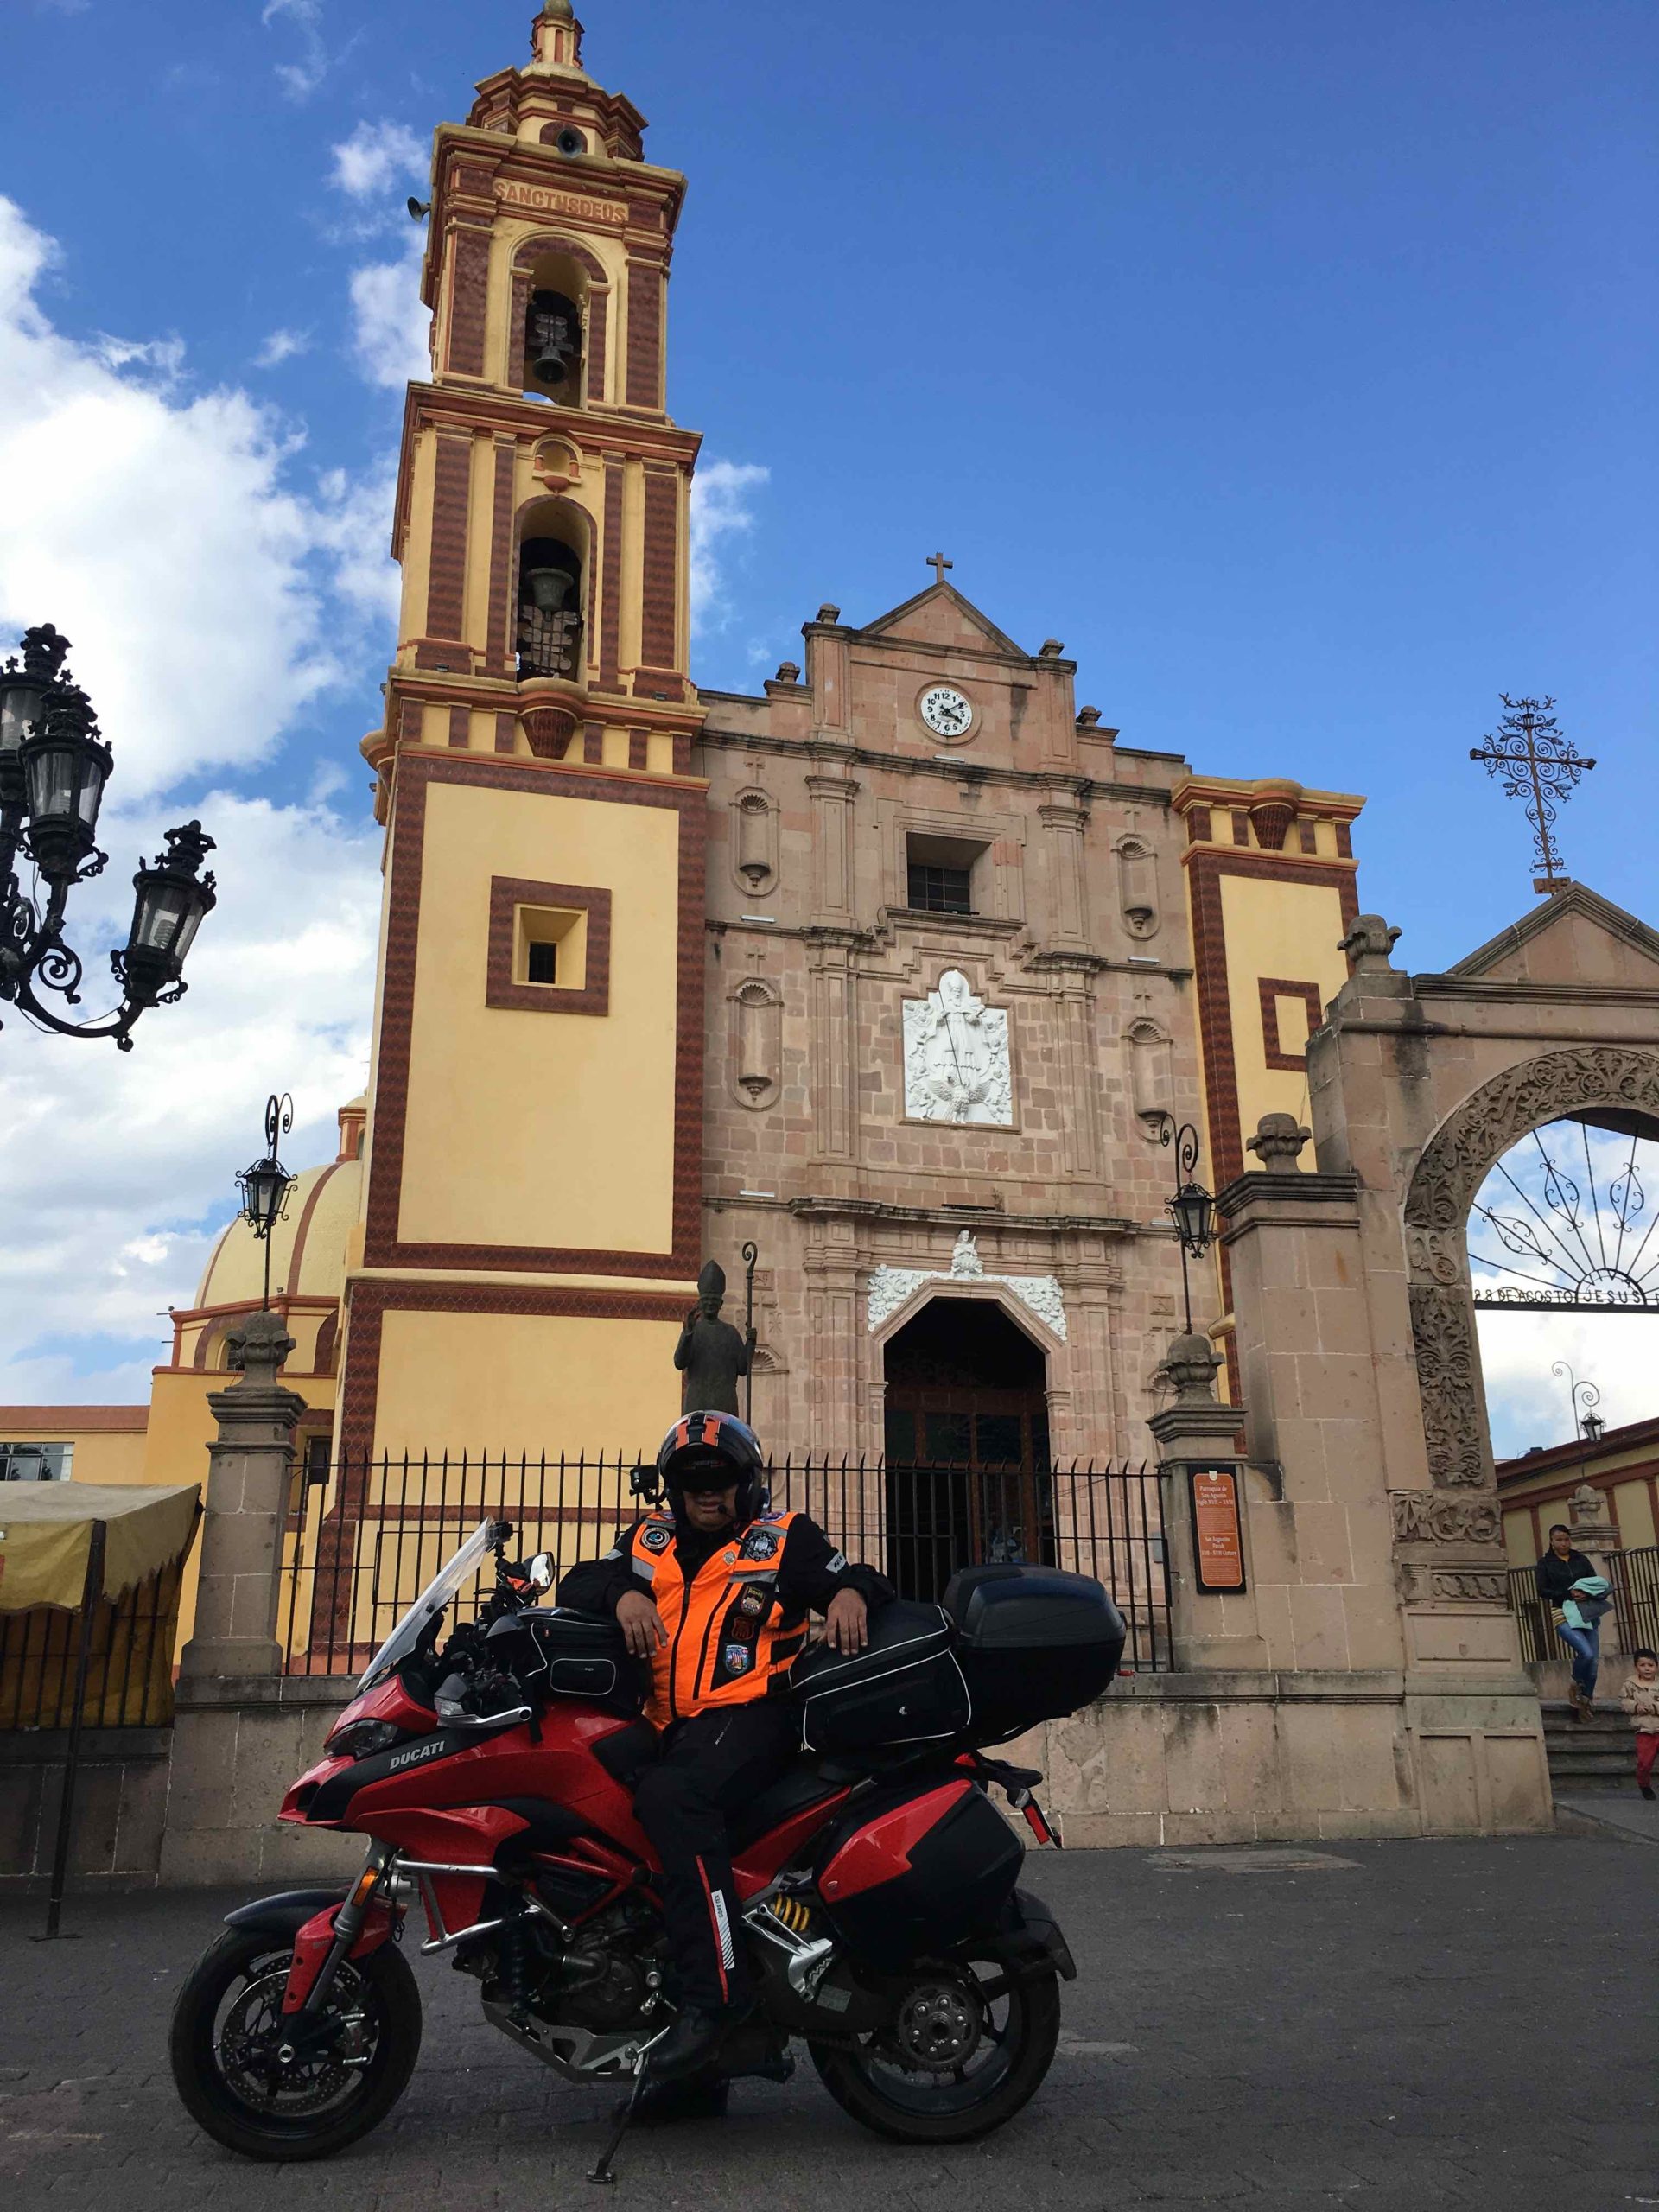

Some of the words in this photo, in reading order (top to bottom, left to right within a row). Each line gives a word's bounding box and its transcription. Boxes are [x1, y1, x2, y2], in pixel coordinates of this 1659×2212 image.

[1519, 1290, 1573, 1303] AGOSTO
[1583, 1289, 1641, 1304] JESUS
[389, 1740, 445, 1770] DUCATI
